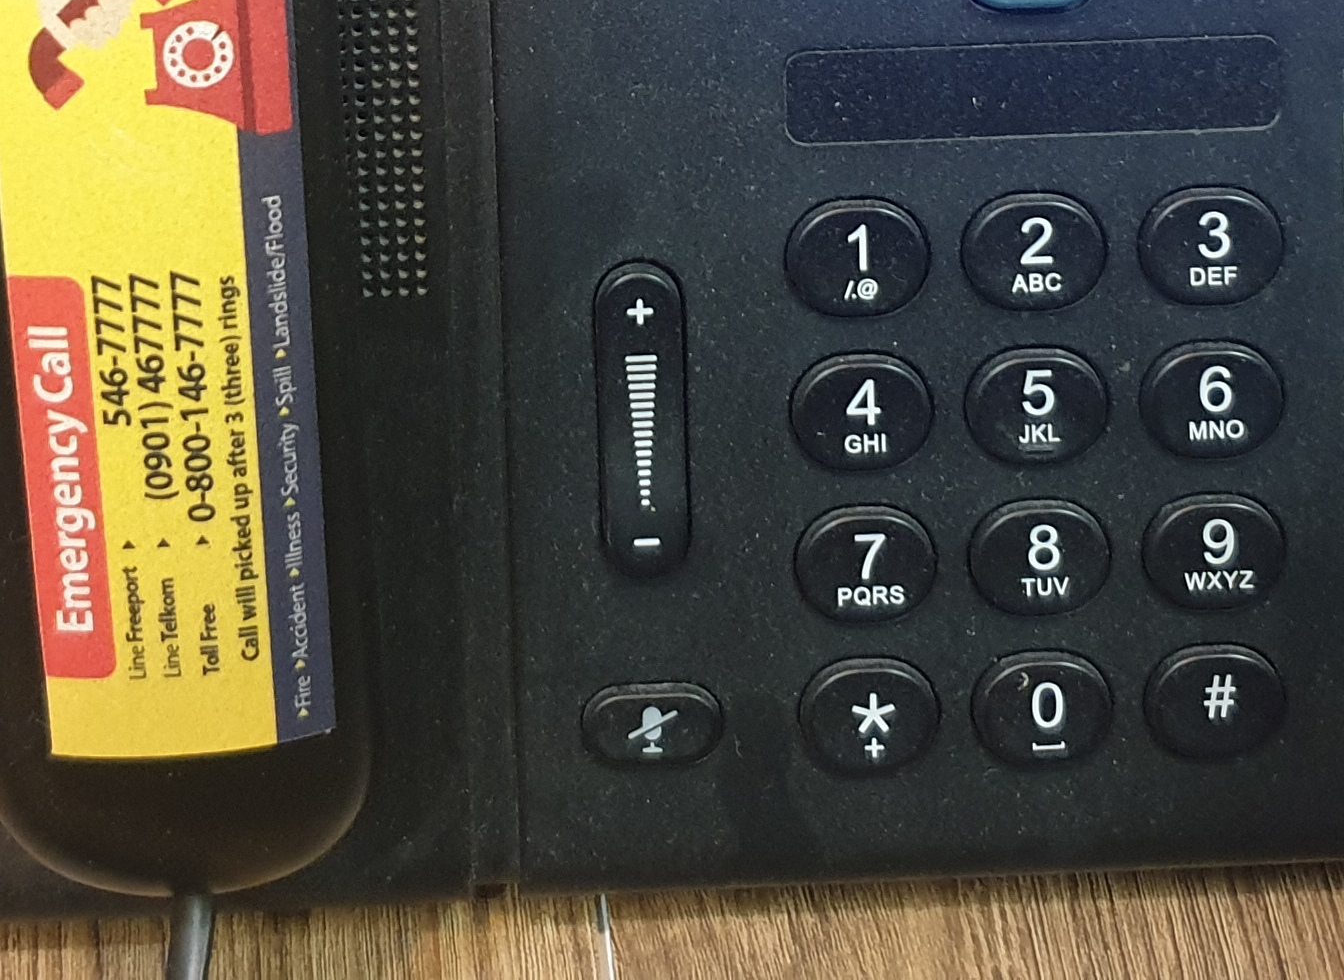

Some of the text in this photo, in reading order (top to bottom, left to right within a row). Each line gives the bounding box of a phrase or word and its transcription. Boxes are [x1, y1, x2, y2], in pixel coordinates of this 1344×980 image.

[848, 225, 867, 271] 1
[1021, 218, 1053, 264] 2
[1199, 212, 1230, 258] 3
[1012, 273, 1061, 293] ABC
[1190, 266, 1237, 286] DEF
[847, 379, 881, 425] 4
[1023, 370, 1054, 415] 5
[1200, 366, 1232, 412] 6
[260, 194, 312, 708] Fire Accident Illness Security Spill Landslide/Flood
[845, 434, 886, 453] GHI
[1019, 424, 1060, 443] JKL
[1189, 420, 1244, 440] MNO
[27, 325, 97, 631] Emergency Call
[90, 274, 147, 680] Line Freeport 546-7777
[128, 272, 181, 677] Line Telkom (0901) 467777
[170, 269, 220, 675] Toll Free 0-800-146-7777
[216, 274, 259, 661] Call will picked up after 3 (three) rings
[855, 534, 885, 579] 7
[1029, 525, 1060, 570] 8
[1203, 519, 1234, 564] 9
[838, 586, 904, 606] PQRS
[1021, 577, 1069, 596] TUV
[1185, 571, 1253, 590] WXYZ
[1032, 683, 1063, 728] 0
